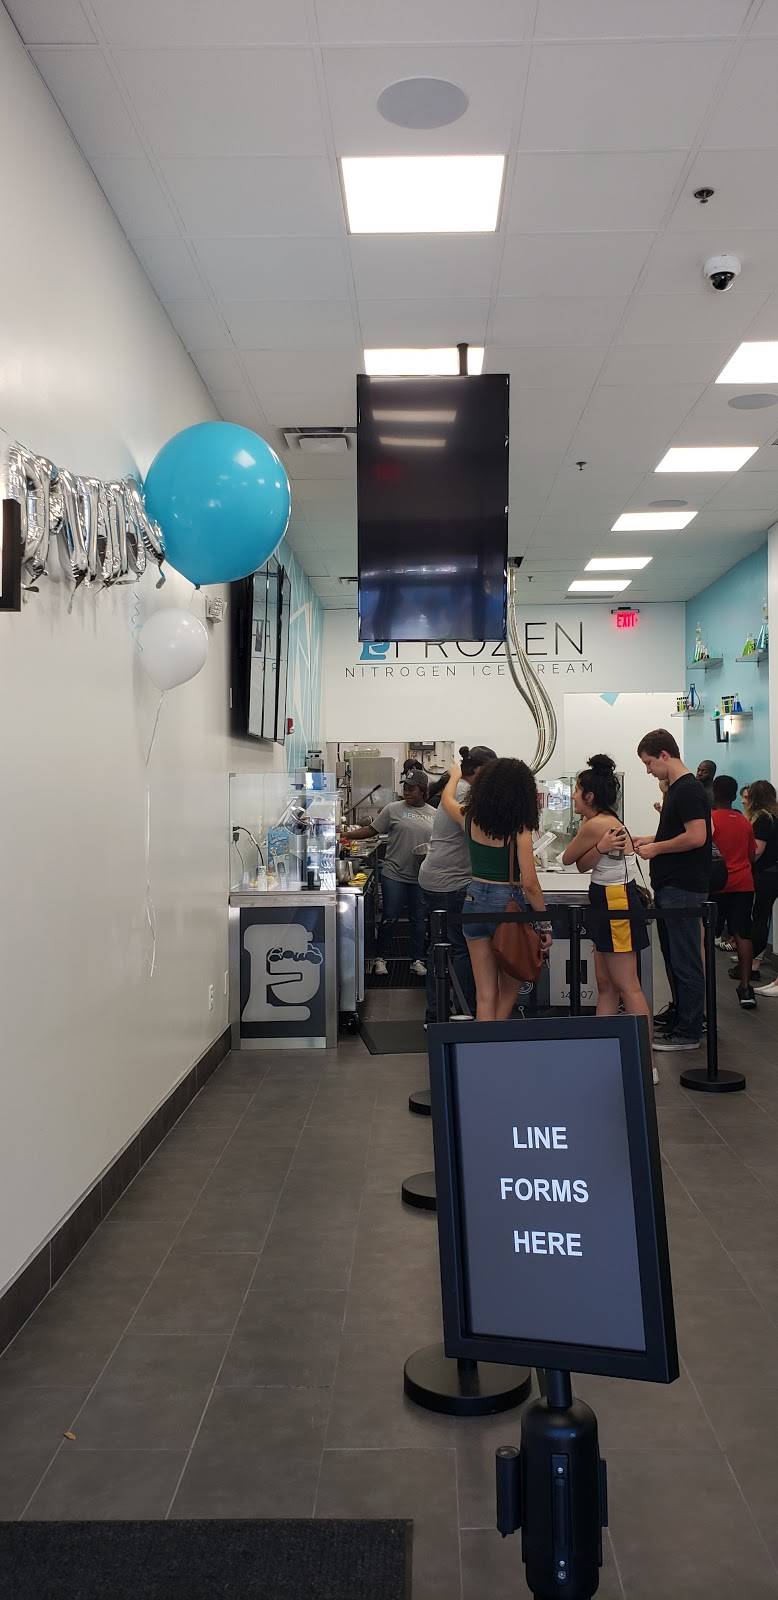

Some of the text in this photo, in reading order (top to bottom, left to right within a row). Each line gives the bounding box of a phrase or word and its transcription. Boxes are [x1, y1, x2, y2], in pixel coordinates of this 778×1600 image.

[617, 613, 635, 627] EXIT
[345, 662, 594, 678] NITROGEN ICE REAM
[512, 1126, 568, 1150] LINE
[500, 1177, 589, 1203] FORMS
[513, 1230, 583, 1257] HERE
